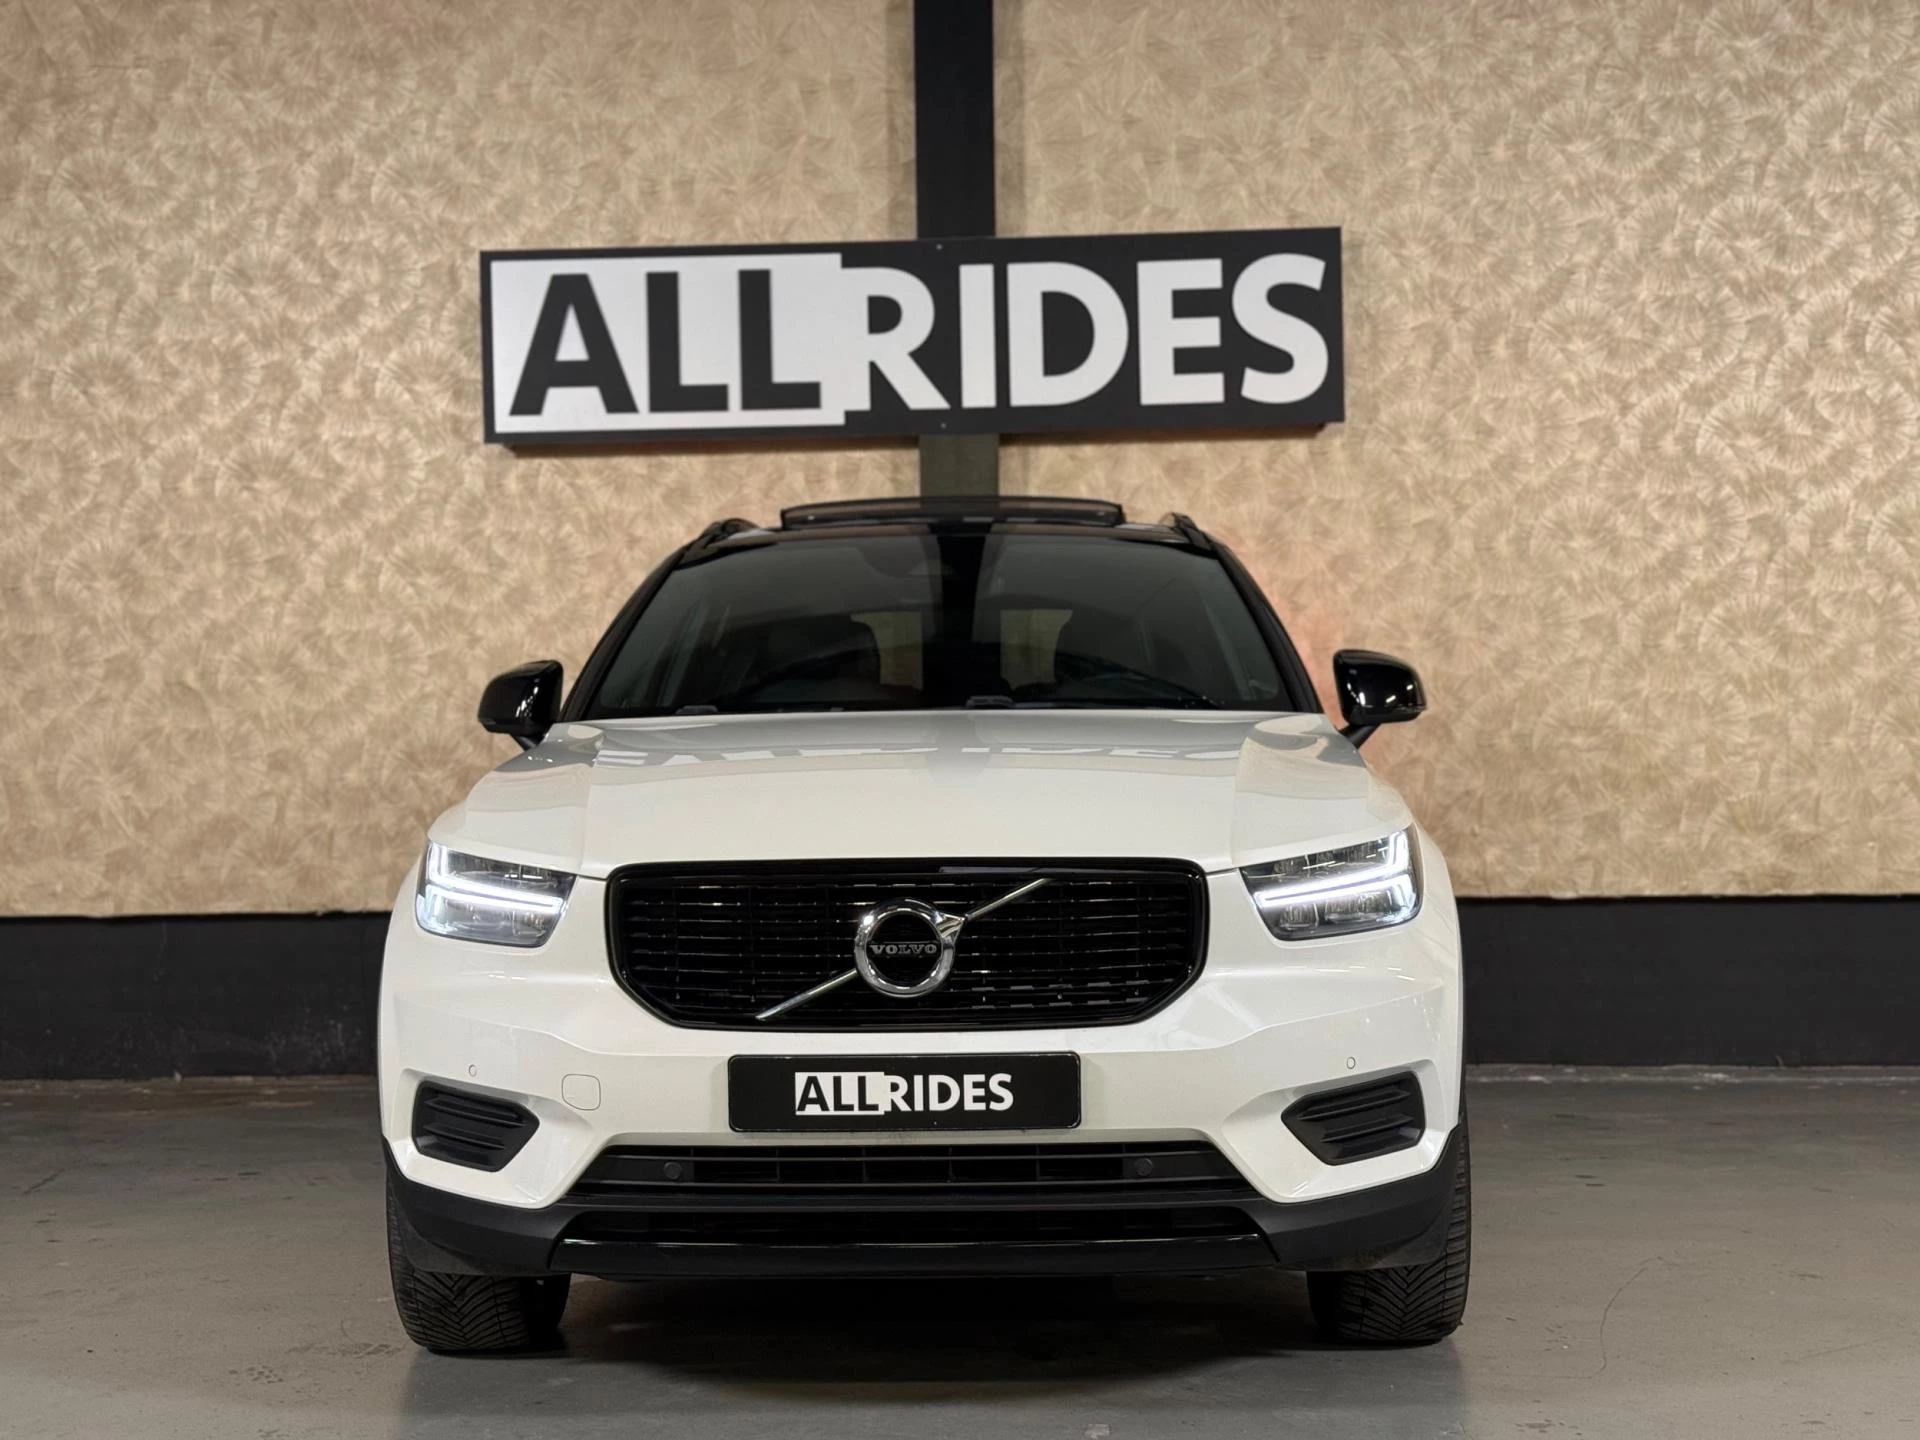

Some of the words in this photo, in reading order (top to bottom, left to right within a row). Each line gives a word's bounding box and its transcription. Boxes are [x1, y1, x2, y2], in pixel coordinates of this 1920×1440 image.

[508, 253, 1330, 416] ALLRIDES
[869, 943, 937, 955] VOLVO
[796, 1072, 1014, 1112] ALLRIDES
